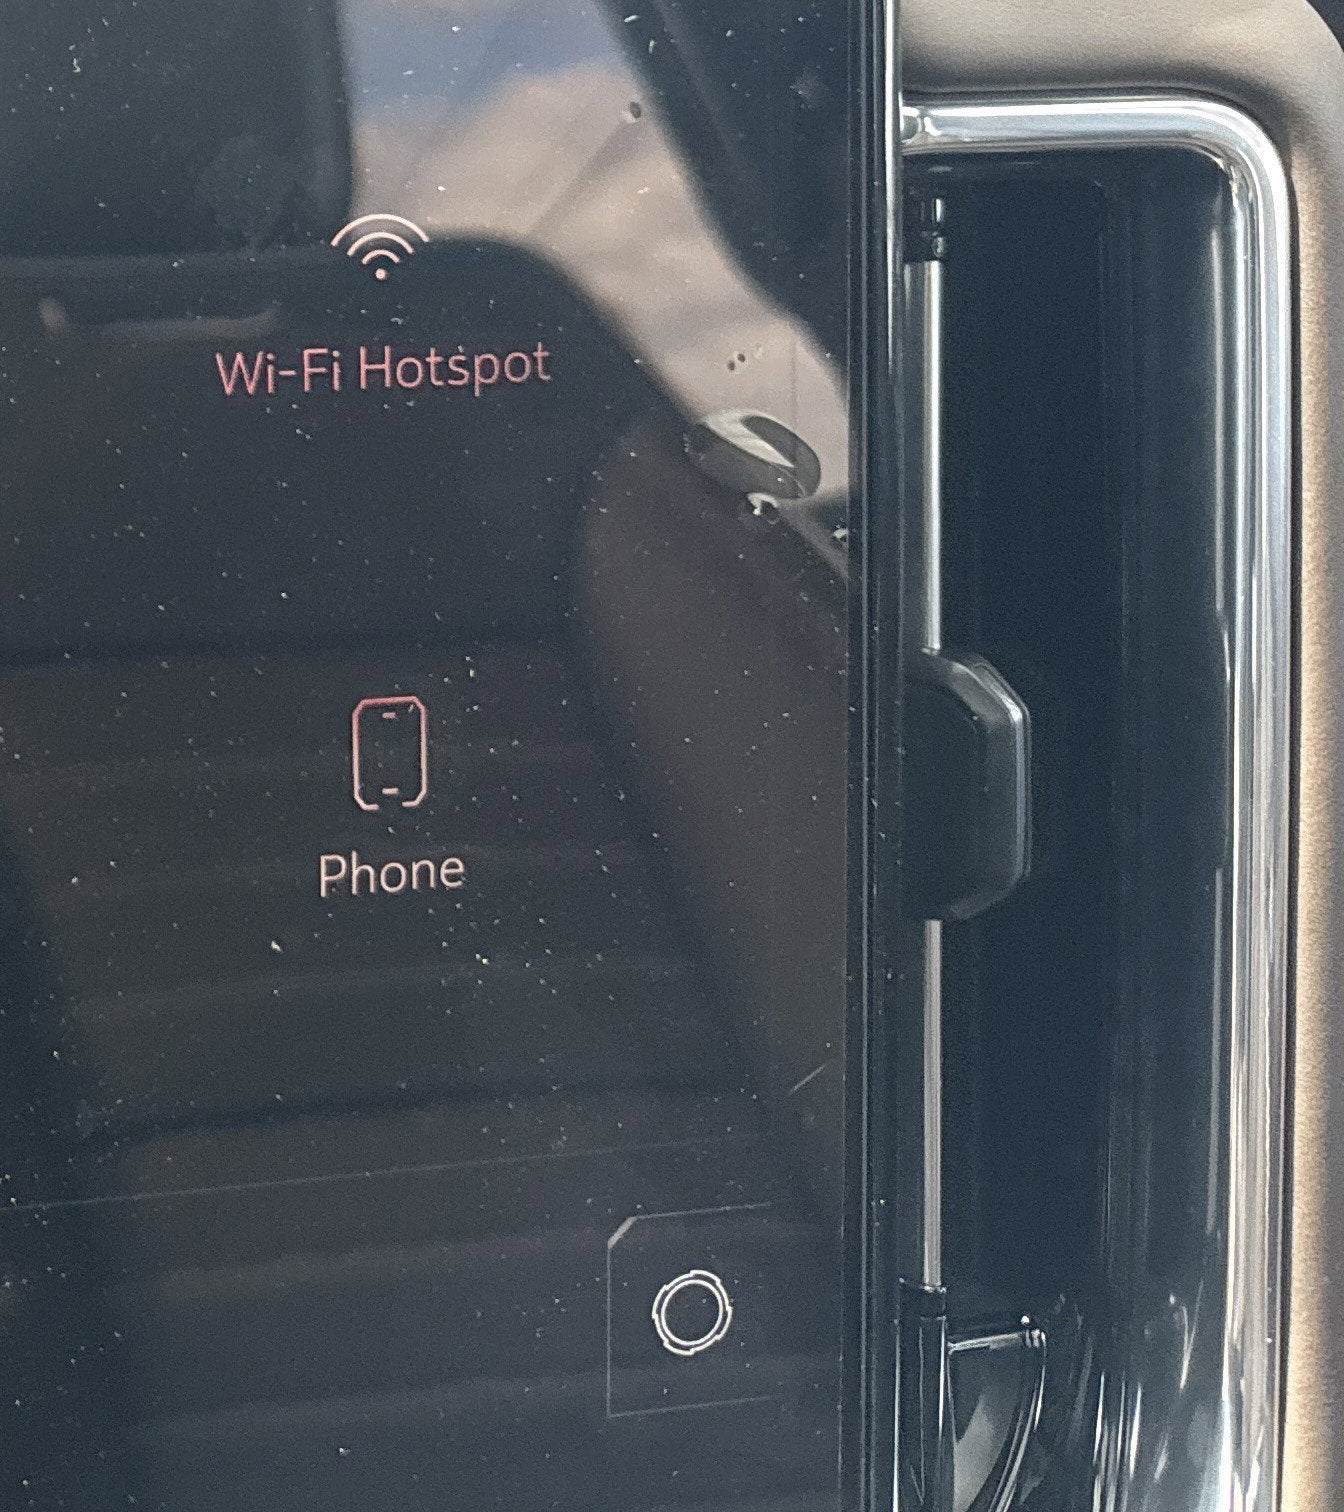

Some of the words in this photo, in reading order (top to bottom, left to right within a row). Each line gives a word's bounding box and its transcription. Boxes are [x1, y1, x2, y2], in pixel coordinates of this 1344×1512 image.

[214, 346, 343, 397] Wi-Fi
[358, 341, 553, 398] Hotspot
[319, 848, 466, 898] Phone
